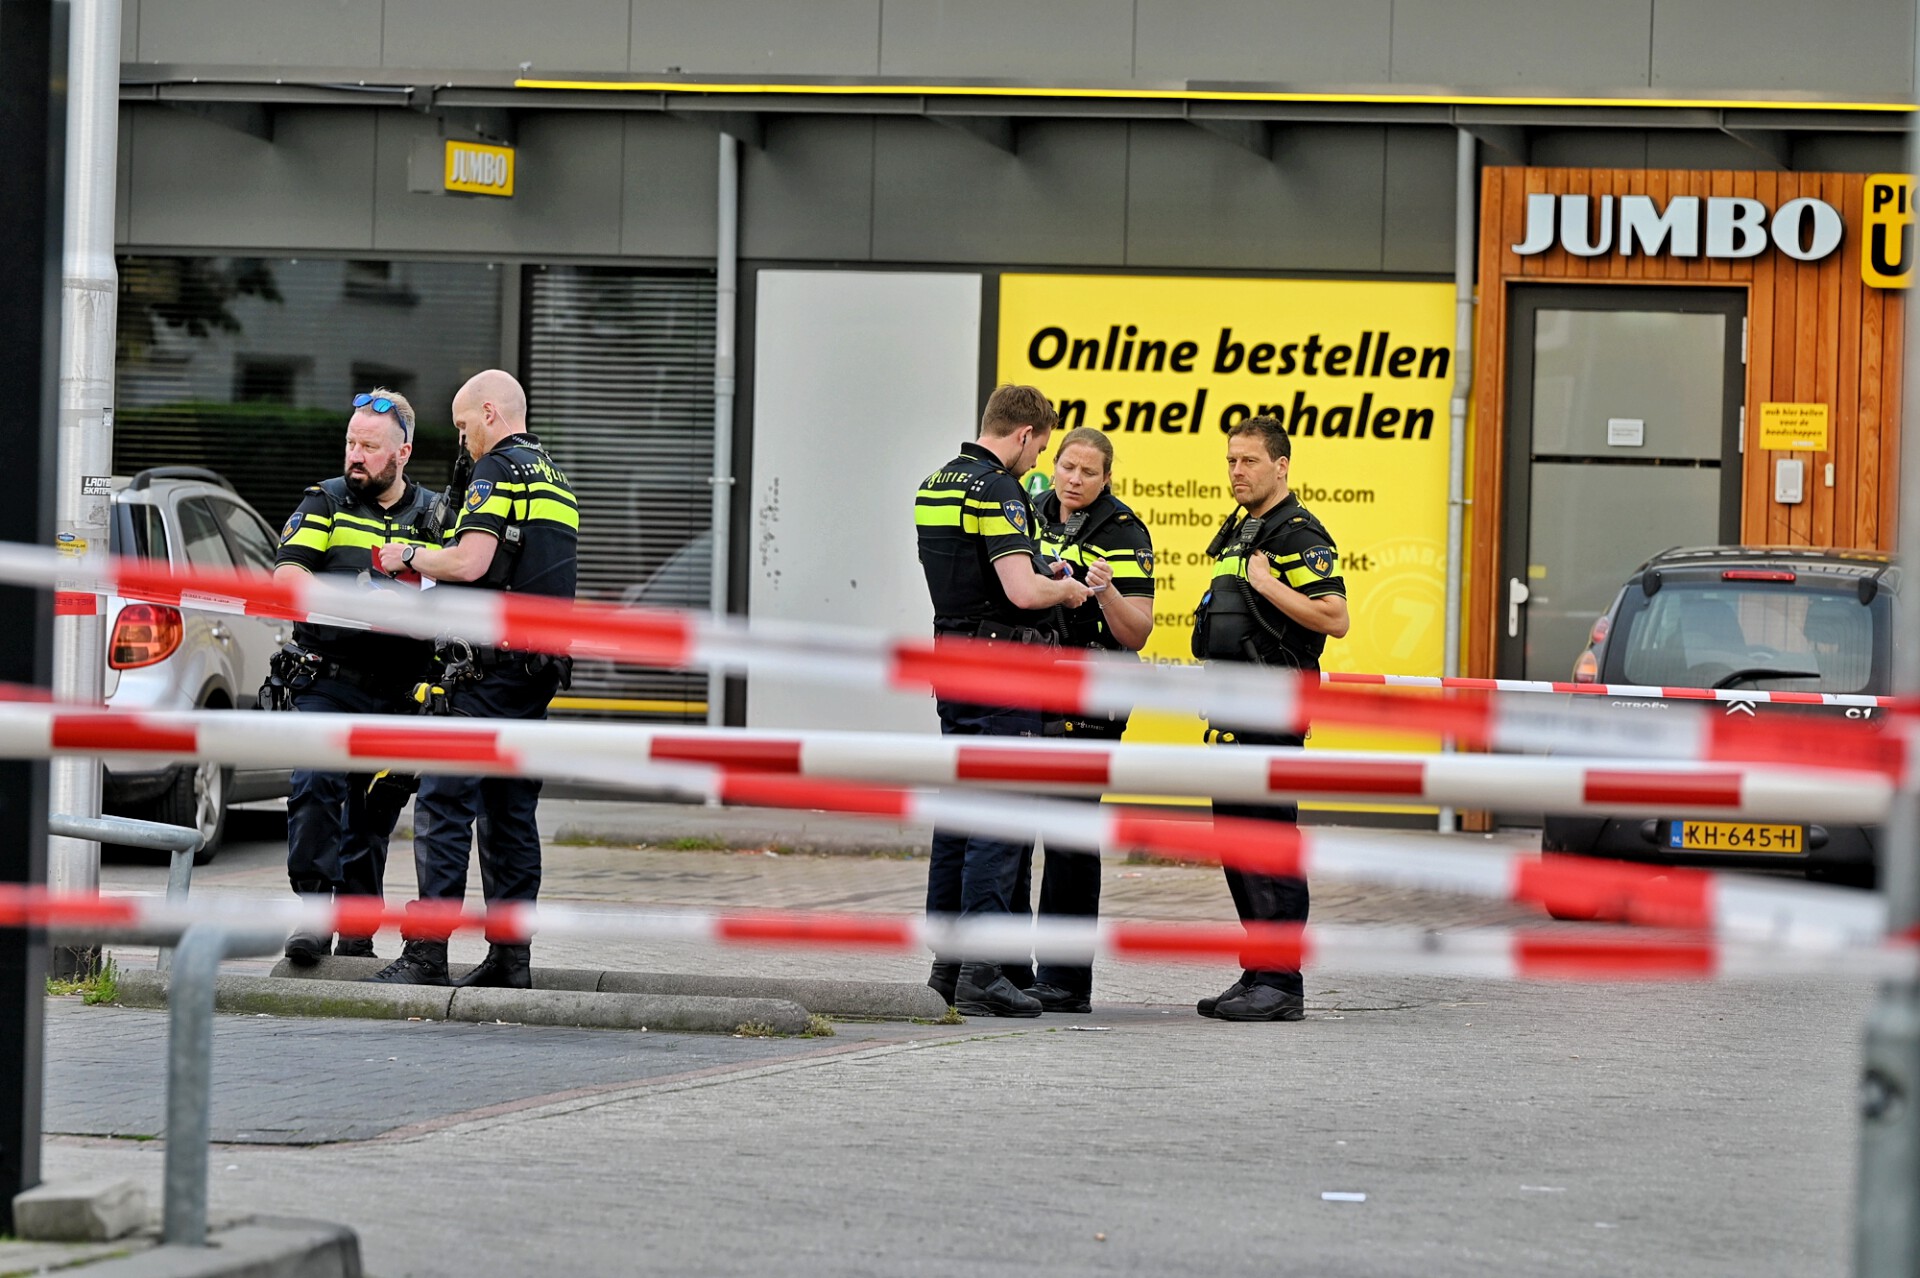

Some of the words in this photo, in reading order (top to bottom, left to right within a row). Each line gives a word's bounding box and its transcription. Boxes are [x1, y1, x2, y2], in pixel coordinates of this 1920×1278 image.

[451, 149, 507, 187] JUMBO
[1511, 193, 1843, 261] JUMBO
[1028, 325, 1199, 373] Online
[1213, 328, 1451, 379] bestellen
[1047, 399, 1087, 431] n
[1102, 388, 1208, 434] snel
[1133, 478, 1221, 499] bestellen
[1148, 507, 1213, 528] Jumbo
[1845, 707, 1872, 720] C1
[1688, 825, 1796, 848] KH-645-H
